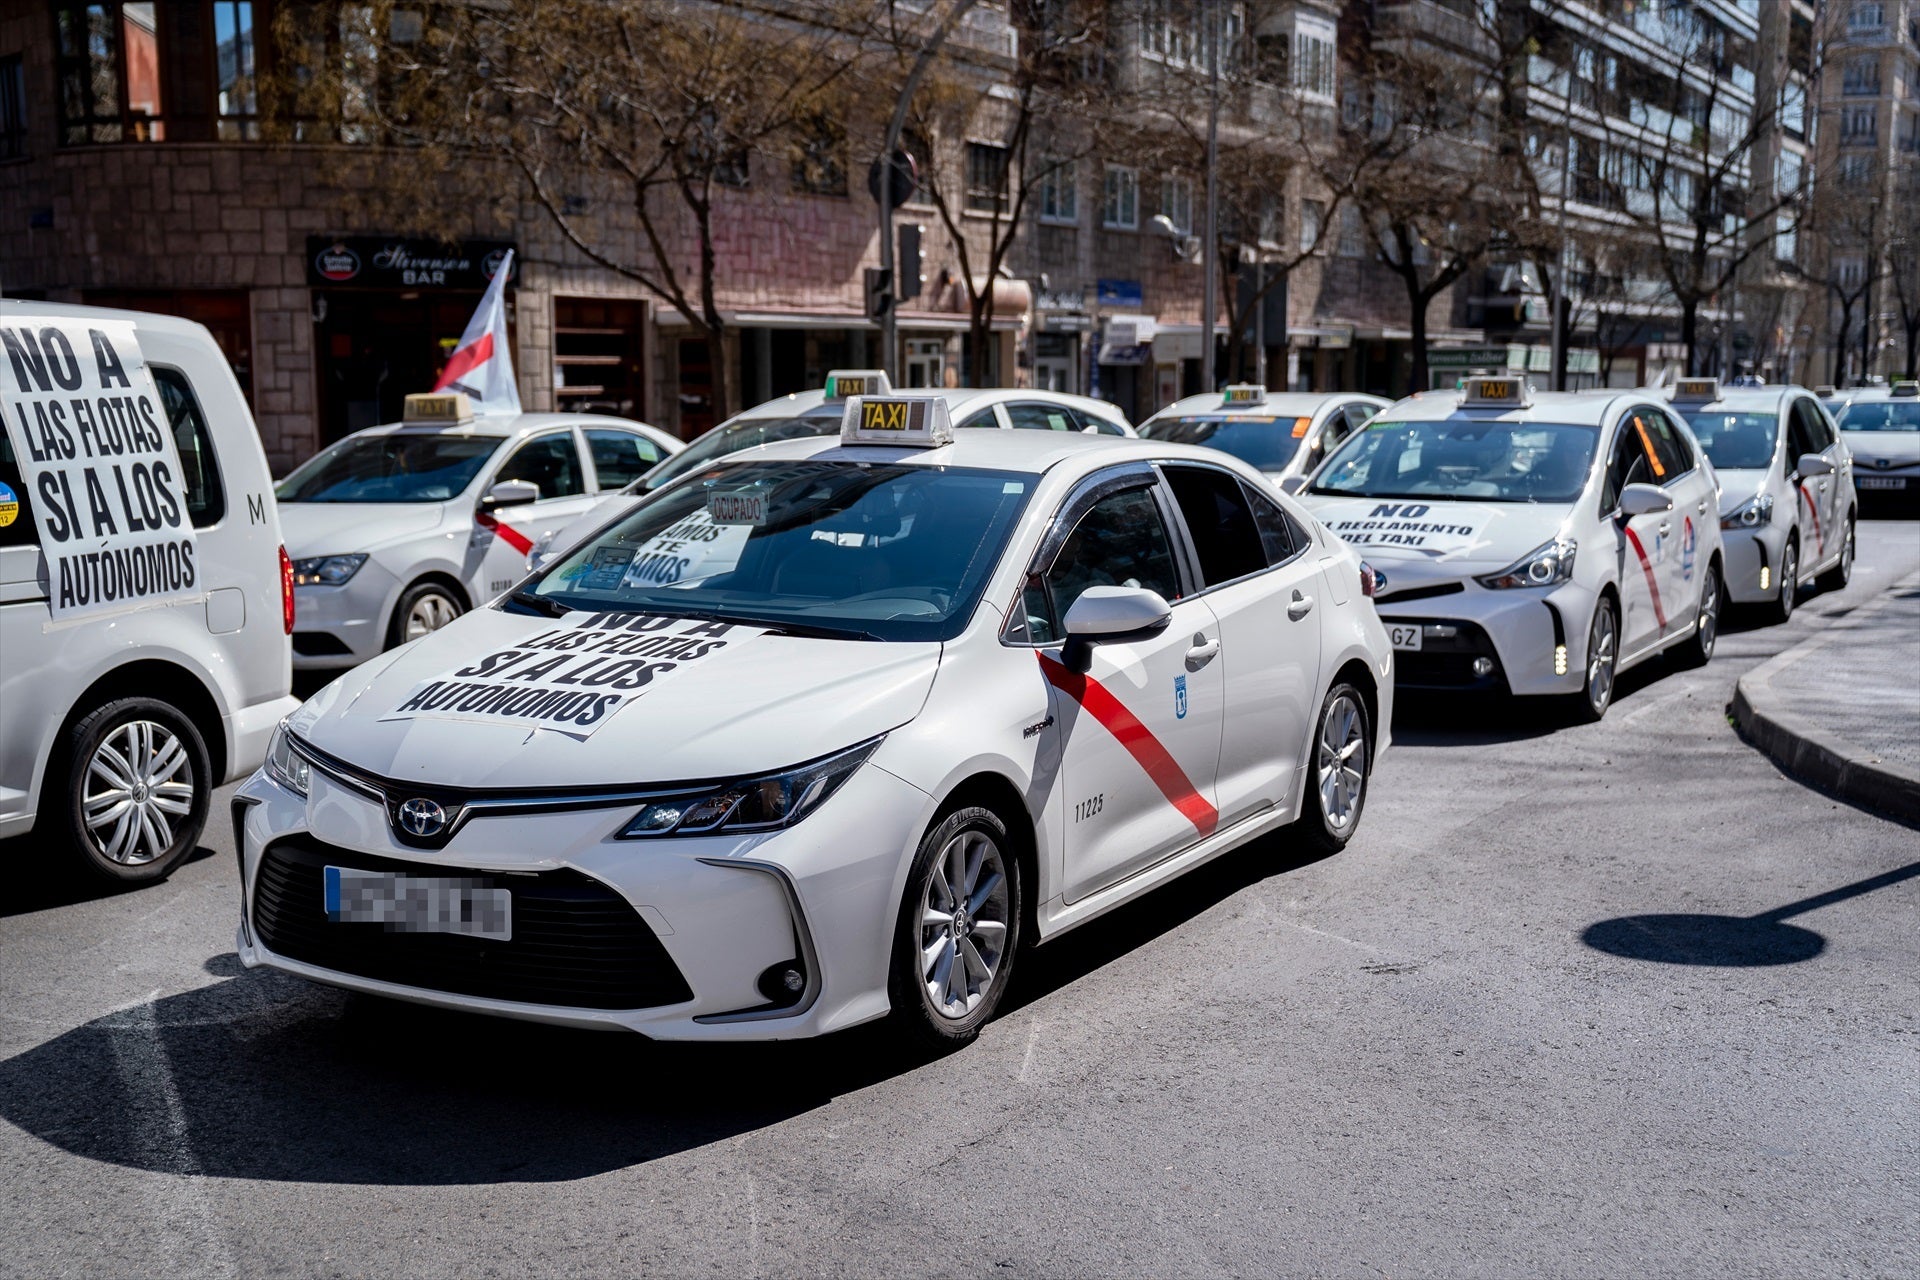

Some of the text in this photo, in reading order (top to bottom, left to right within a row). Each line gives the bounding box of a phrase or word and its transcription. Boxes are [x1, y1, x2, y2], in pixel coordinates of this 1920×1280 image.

[403, 270, 445, 285] BAR
[0, 327, 132, 393] NO A
[839, 379, 864, 395] TAXI
[1482, 382, 1508, 398] TAXI
[418, 402, 446, 415] TAXI
[862, 403, 907, 428] TAXI
[15, 395, 163, 462] LAS FLOTAS
[37, 460, 181, 543] SI A LOS
[246, 493, 267, 525] M
[714, 497, 761, 521] OCUPADO
[1368, 504, 1430, 518] NO
[1337, 521, 1473, 536] REGLAMENTO
[1379, 534, 1426, 546] TAXI
[654, 540, 687, 553] TE
[59, 539, 195, 609] AUTÓNOMOS
[576, 613, 666, 632] NO
[514, 630, 728, 661] LAS FLOTAS
[454, 650, 678, 690] SI A LOS
[1075, 793, 1103, 823] 11225
